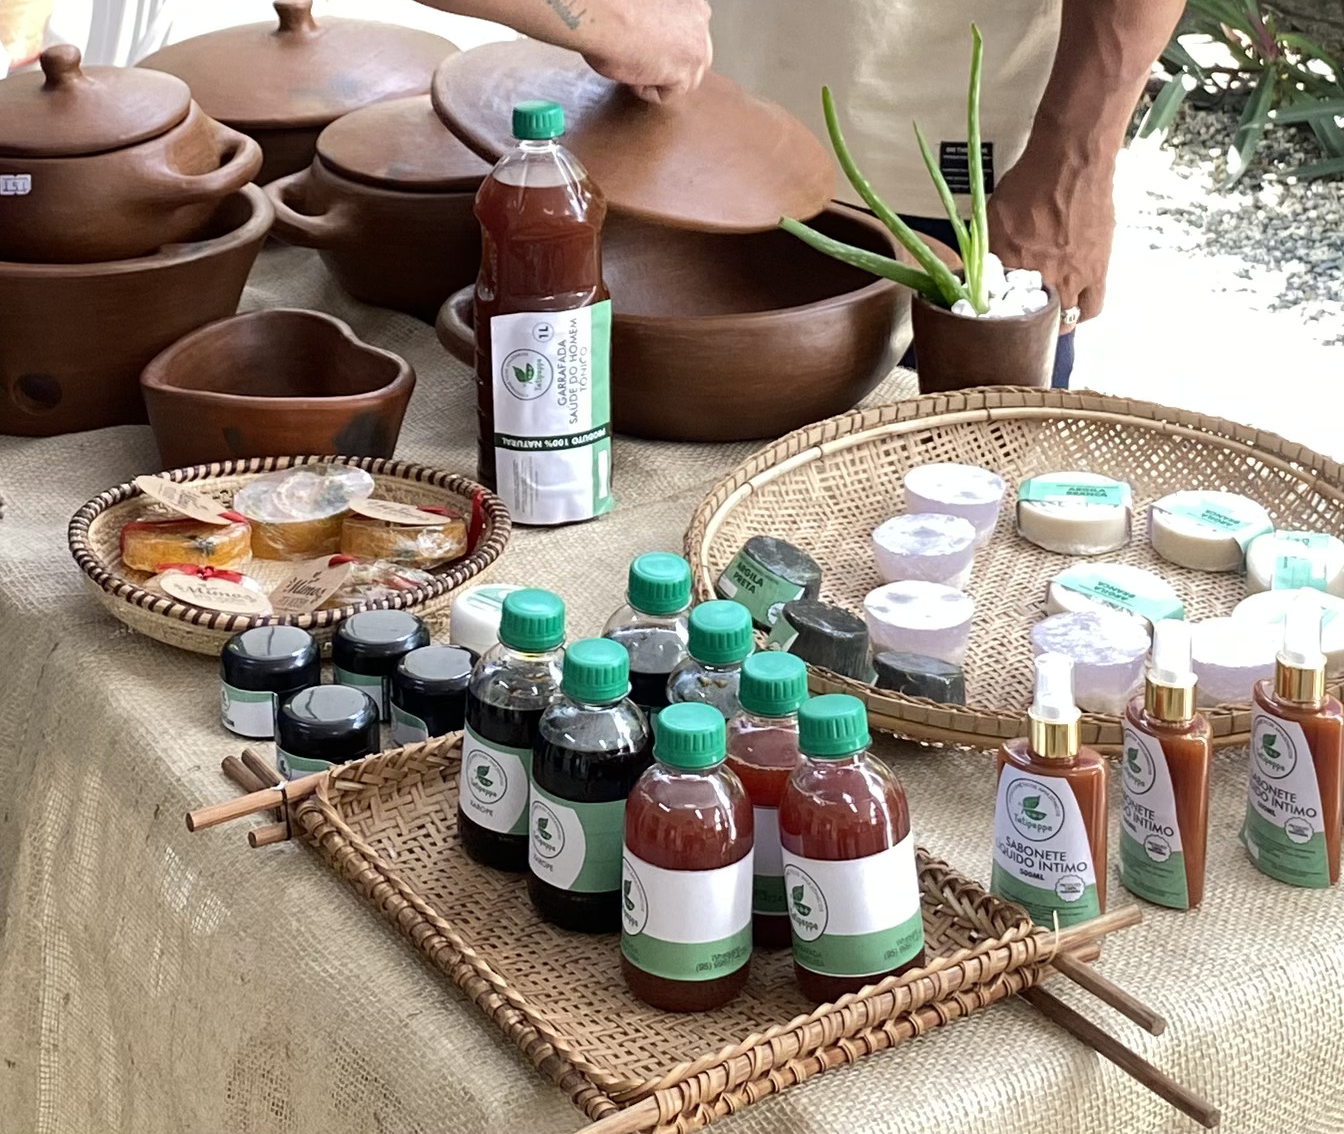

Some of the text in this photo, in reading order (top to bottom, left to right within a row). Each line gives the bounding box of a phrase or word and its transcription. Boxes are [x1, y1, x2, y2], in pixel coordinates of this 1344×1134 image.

[538, 325, 549, 339] 1L
[557, 339, 567, 406] GARRAFADA
[568, 318, 578, 424] SAÚDE DO HOMEM
[501, 427, 606, 448] PRODUTO 100% NATURAL
[733, 571, 756, 594] PRETA
[737, 561, 763, 587] ARGILA
[1252, 773, 1297, 804] ABONETE
[996, 837, 1087, 874] QUIDO ÍNTIMO
[1005, 835, 1067, 862] SABONETE
